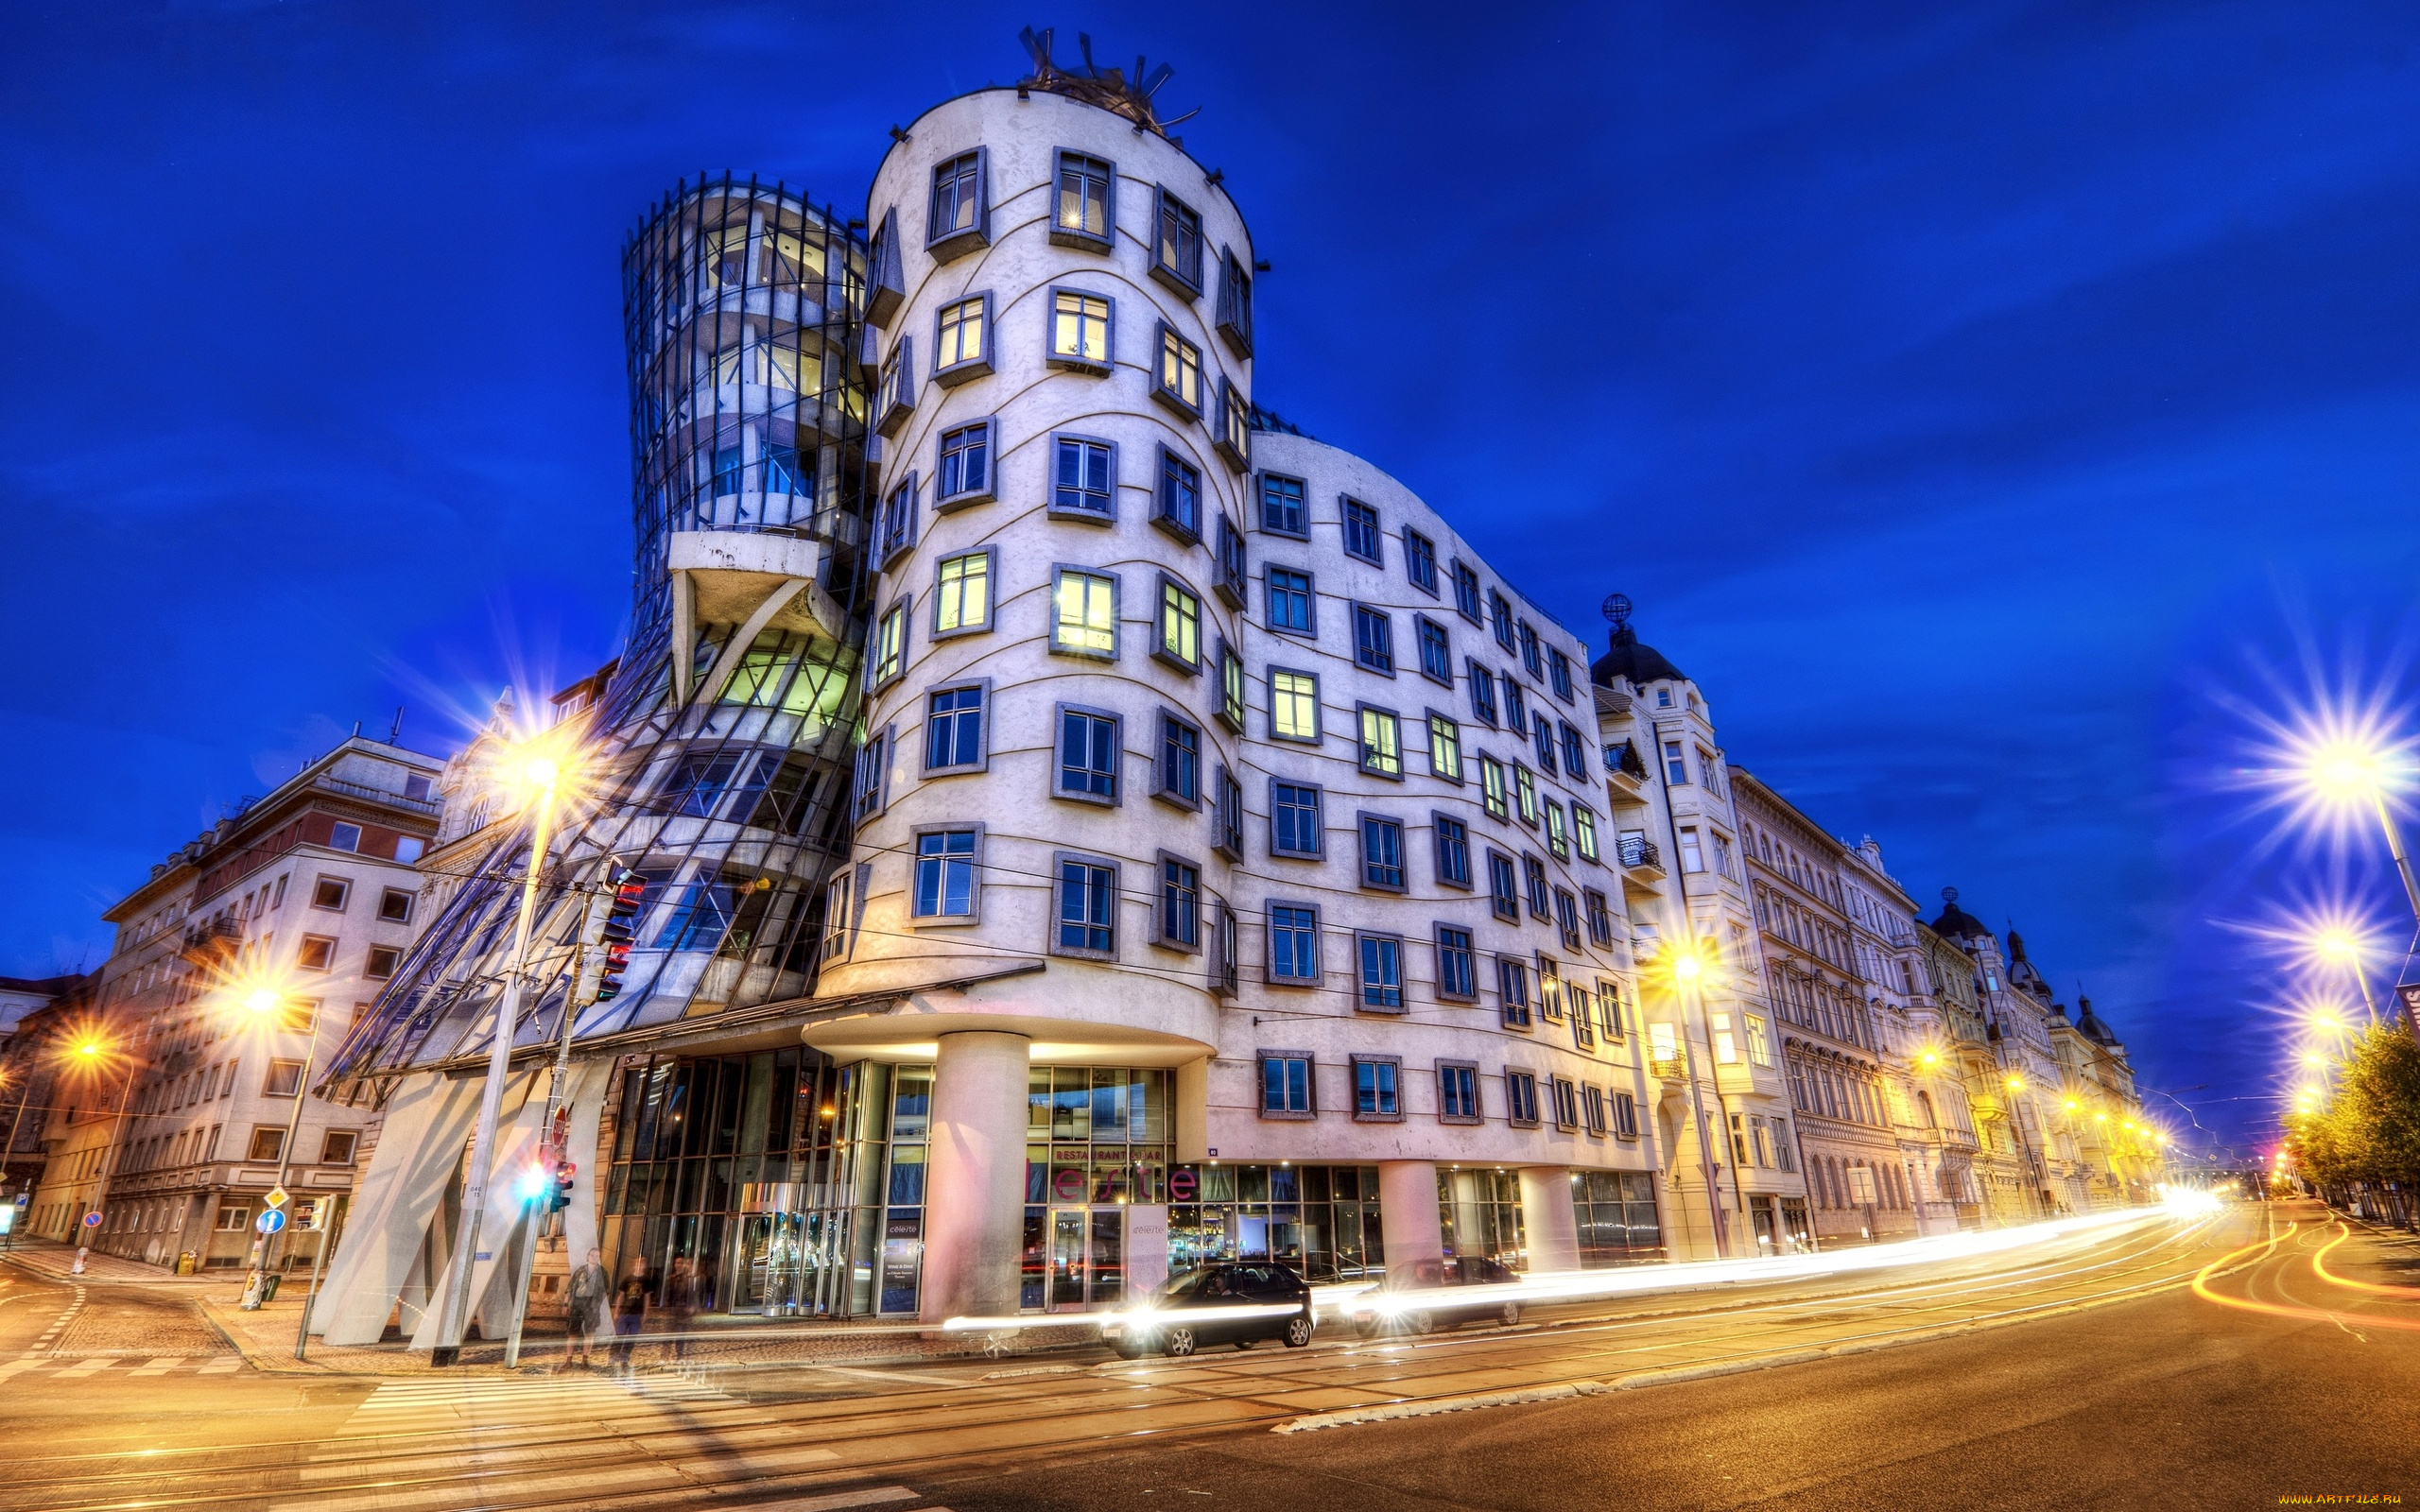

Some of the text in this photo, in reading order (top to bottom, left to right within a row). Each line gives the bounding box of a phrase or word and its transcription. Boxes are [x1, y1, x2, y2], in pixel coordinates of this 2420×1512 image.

[1056, 1151, 1161, 1160] RESTAURANT & BAR
[1025, 1158, 1196, 1201] leste
